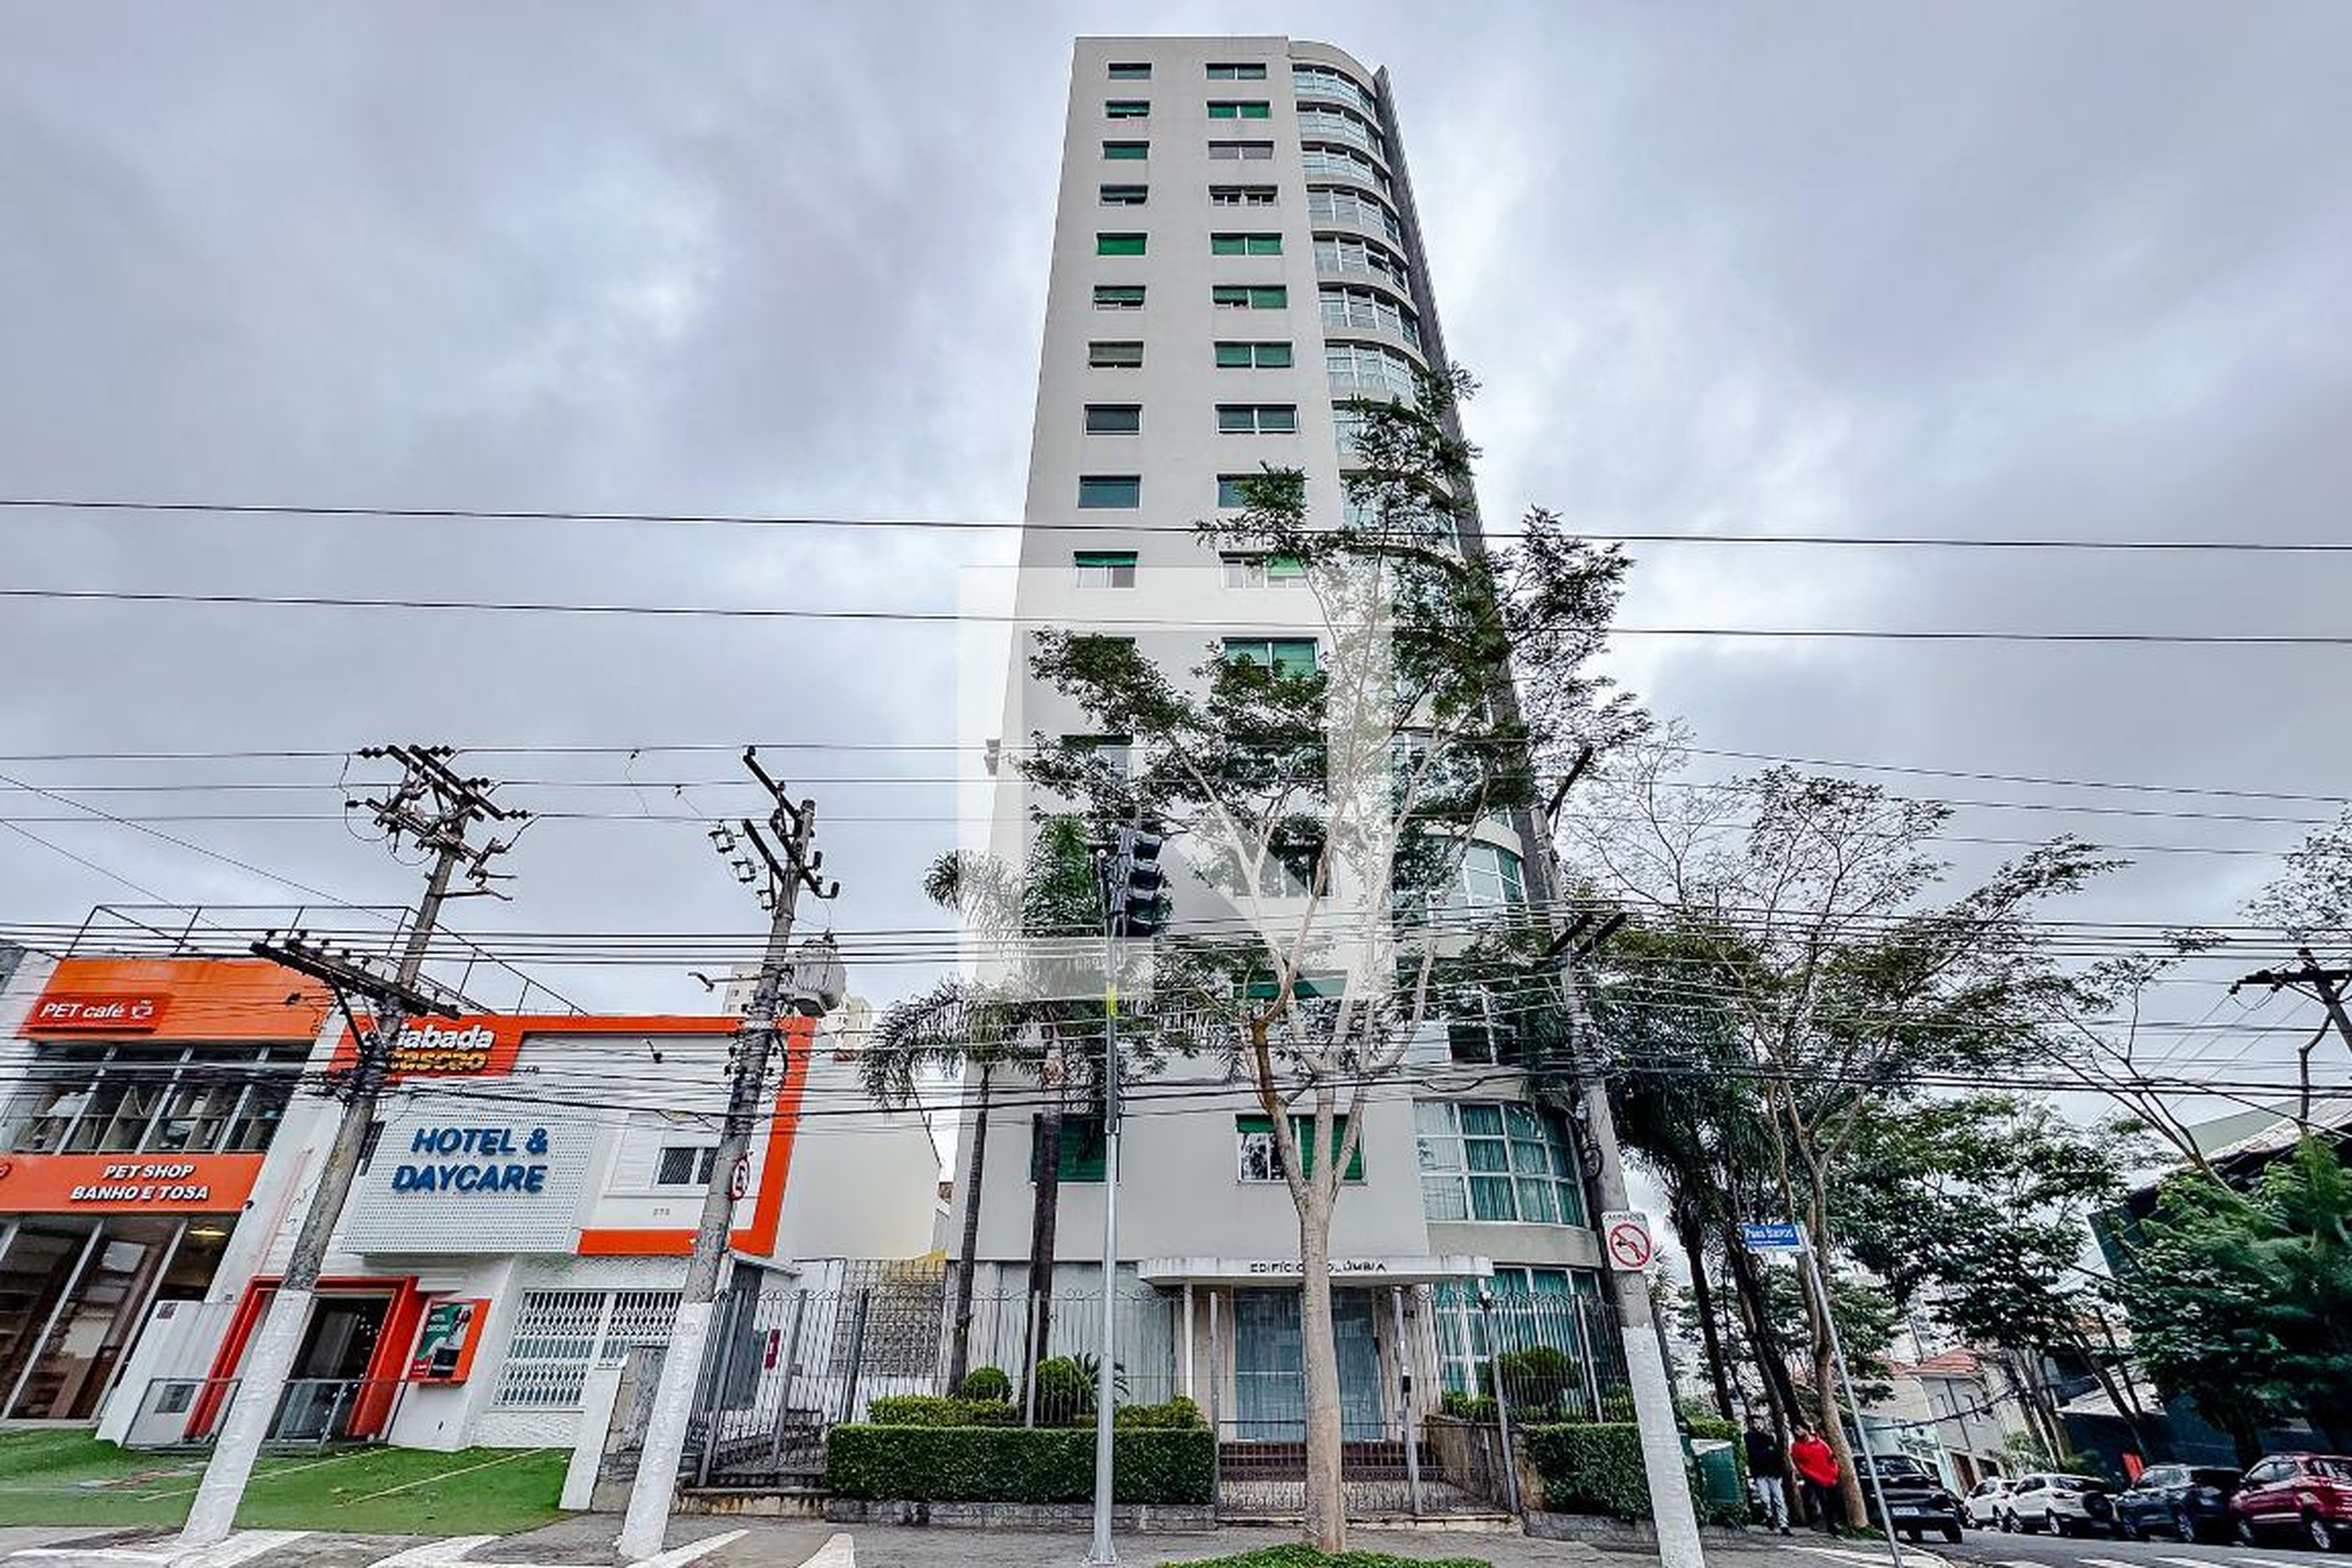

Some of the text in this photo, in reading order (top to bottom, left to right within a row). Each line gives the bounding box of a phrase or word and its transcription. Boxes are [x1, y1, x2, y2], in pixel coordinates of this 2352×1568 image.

[39, 1001, 124, 1018] PET café
[360, 1023, 494, 1050] iabada
[410, 1127, 548, 1155] HOTEL &
[103, 1165, 196, 1178] PET SHOP
[392, 1164, 548, 1192] DAYCARE
[70, 1186, 209, 1200] BANHO E TOSA
